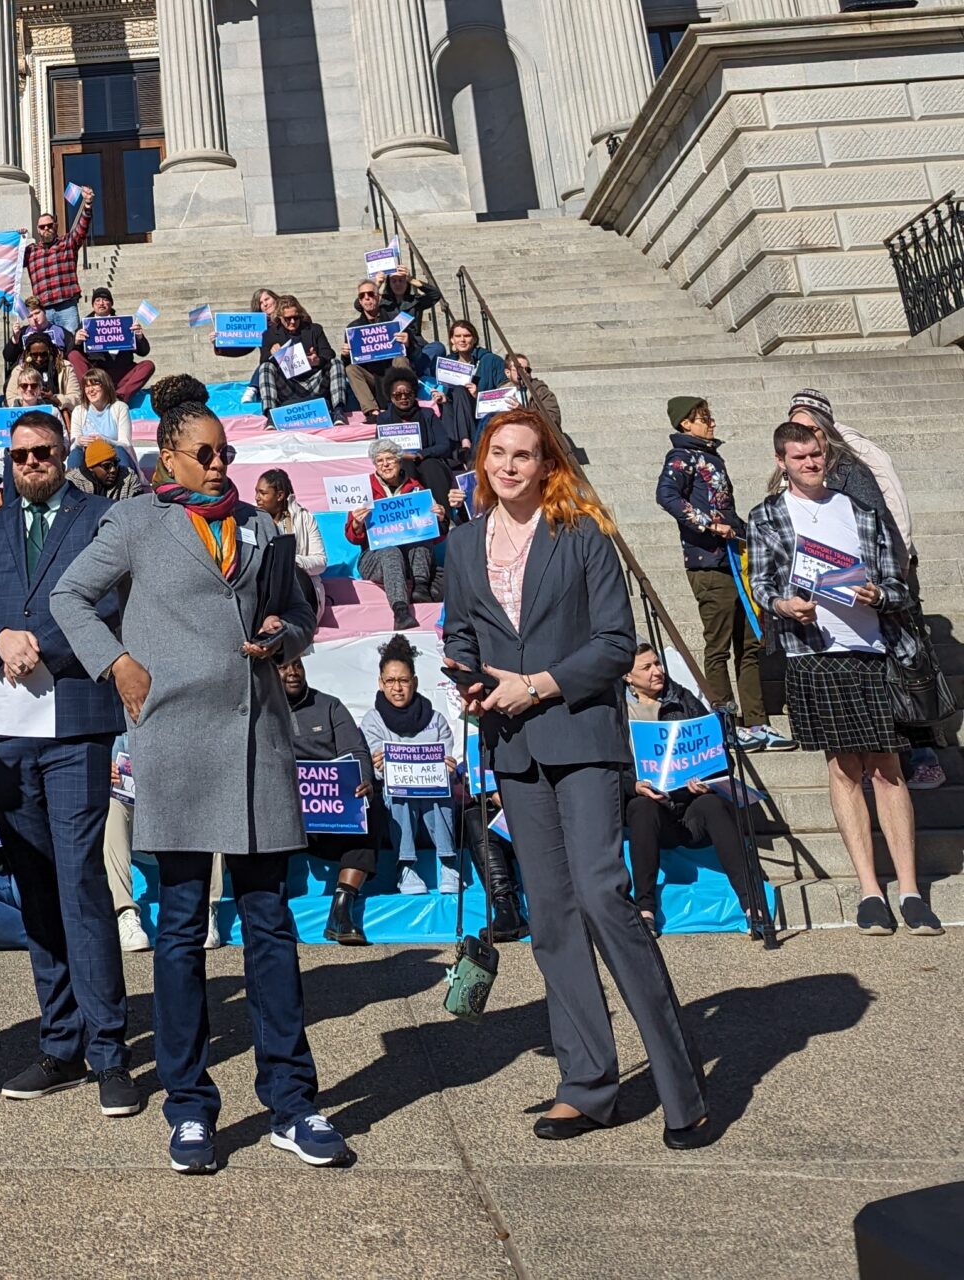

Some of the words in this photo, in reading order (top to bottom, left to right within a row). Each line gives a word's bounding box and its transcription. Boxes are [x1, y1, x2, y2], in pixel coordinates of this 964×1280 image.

[96, 318, 121, 327] TRANS
[229, 315, 253, 323] DON'T
[96, 327, 122, 335] YOUTH
[226, 323, 256, 331] DISRUPT
[360, 325, 387, 336] TRANS
[94, 334, 125, 343] BELONG
[361, 334, 389, 344] YOUTH
[360, 342, 393, 353] BELONG
[286, 404, 311, 415] DON'T
[284, 410, 317, 422] DISRUPT
[306, 416, 328, 426] LIVES
[334, 484, 348, 493] NO
[350, 485, 361, 493] on
[330, 497, 342, 505] H.
[345, 495, 369, 505] 4624
[381, 497, 413, 512] DON'T
[378, 507, 421, 524] DISRUPT
[371, 522, 405, 536] TRANS
[390, 745, 420, 753] SUPPORT
[413, 753, 442, 761] BECAUSE
[692, 744, 724, 766] LIVES
[392, 764, 413, 773] THEY
[421, 764, 437, 773] ARE
[297, 767, 339, 781] RANS
[299, 783, 339, 797] OUTH
[301, 799, 345, 814] LONG
